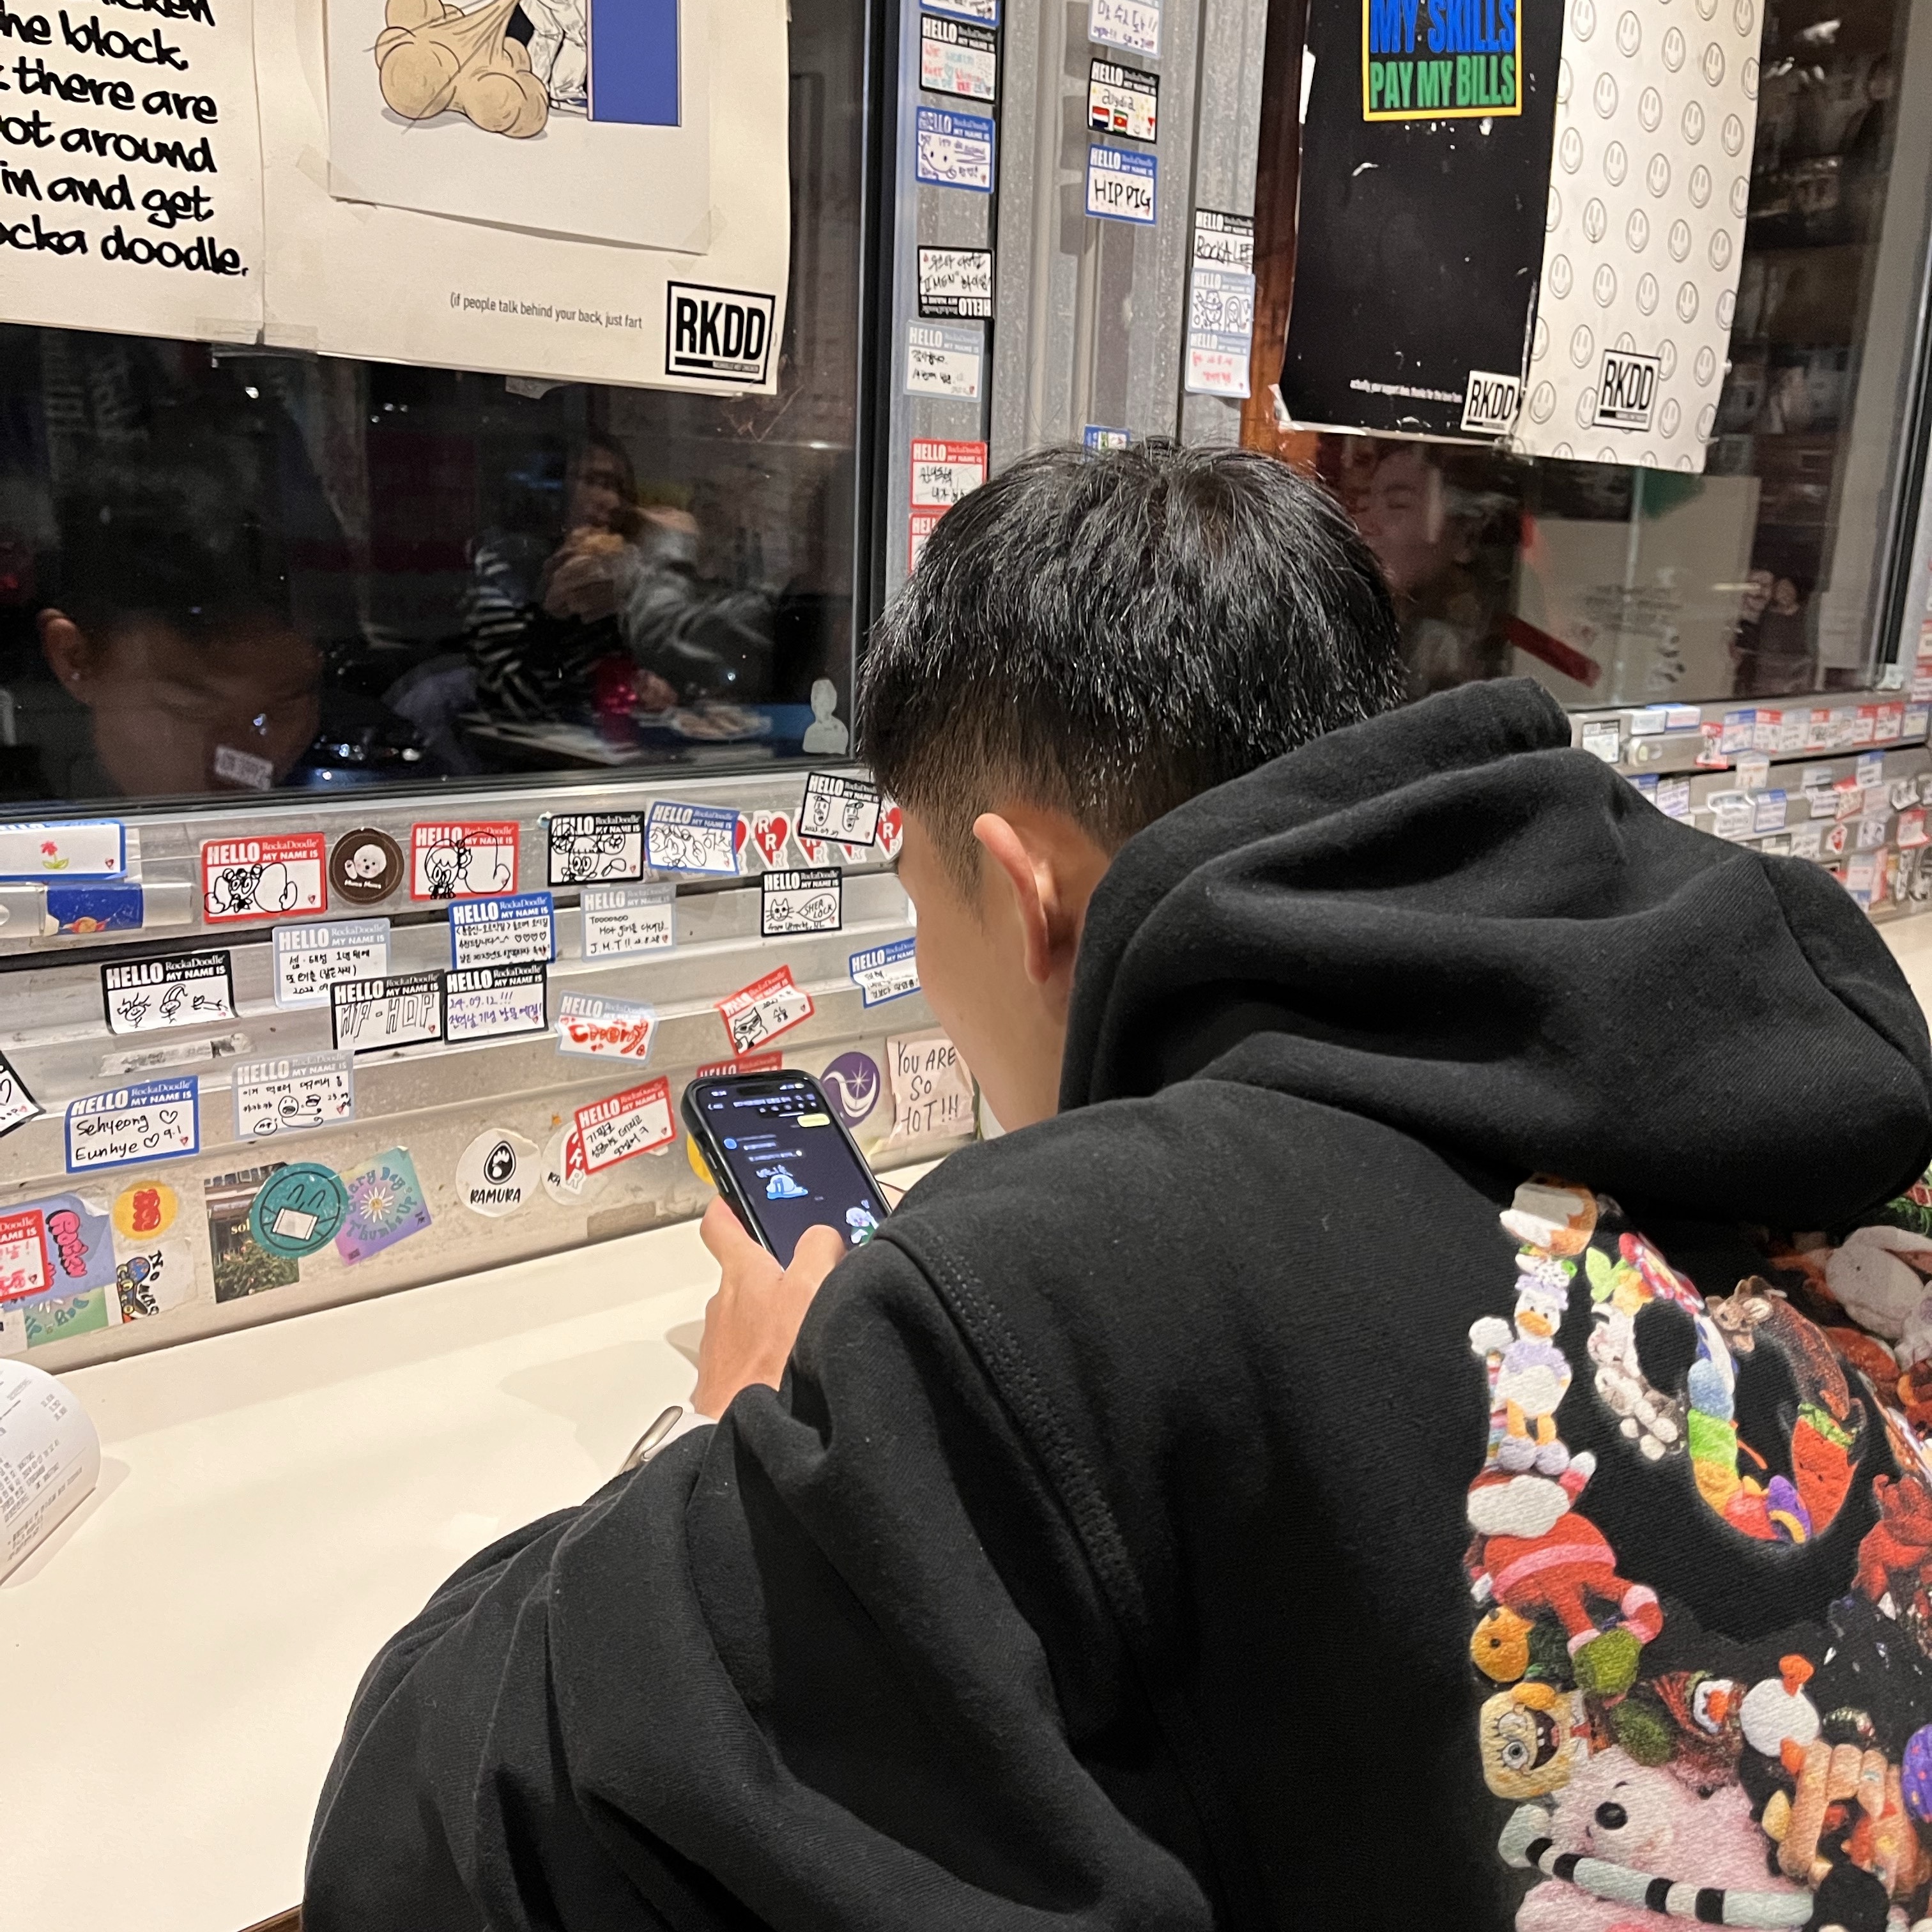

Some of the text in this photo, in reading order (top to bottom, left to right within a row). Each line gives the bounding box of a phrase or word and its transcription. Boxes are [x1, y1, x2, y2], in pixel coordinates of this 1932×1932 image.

[922, 17, 957, 43] HELLO
[1370, 0, 1515, 54] MY SKILLS
[59, 10, 189, 70] block
[1091, 61, 1124, 87] HELLO
[1370, 54, 1515, 109] PAY MY BILLS
[12, 56, 218, 124] there are
[60, 127, 217, 173] around
[1090, 148, 1121, 170] HELLO
[47, 174, 135, 210] and
[141, 185, 214, 229] get
[463, 296, 496, 312] people
[499, 300, 519, 314] talk
[520, 302, 552, 318] behind
[555, 309, 577, 322] your
[605, 314, 623, 327] just
[625, 314, 643, 329] fart
[958, 298, 992, 317] HELLO
[675, 296, 766, 360] RKDD
[908, 326, 943, 348] HELLO
[1601, 359, 1654, 410] RKDD
[1469, 379, 1515, 420] RKDD
[913, 443, 947, 462] HELLO
[808, 774, 845, 796] HELLO
[652, 804, 693, 824] HELLO
[261, 838, 318, 851] RockaDoodle
[416, 827, 463, 847] HELLO
[207, 842, 261, 865] HELLO
[262, 849, 318, 861] MY NAME IS
[763, 871, 801, 891] HELLO
[500, 896, 548, 910] RockaDoodle
[501, 906, 549, 919] MY NAME IS
[584, 891, 626, 912] HELLO
[453, 901, 499, 925] HELLO
[279, 928, 330, 951] HELLO
[331, 924, 385, 937] RockaDoodle
[332, 933, 385, 947] MY NAME IS
[165, 954, 226, 971] RockaDoodle
[852, 949, 885, 972] HELLO
[886, 954, 896, 963] MY
[105, 962, 164, 990] HELLO
[165, 965, 226, 982] MY NAME IS
[386, 973, 440, 988] RockaDoodle
[447, 969, 493, 993] HELLO
[493, 964, 542, 979] RockaDoodle
[494, 974, 542, 988] MY NAME IS
[334, 980, 384, 1005] HELLO
[386, 982, 439, 997] MY NAME IS
[560, 995, 604, 1018] HELLO
[292, 1061, 347, 1077] MY NAME IS
[925, 1046, 956, 1071] ARE
[237, 1060, 289, 1085] HELLO
[130, 1080, 192, 1097] RockaDoodle
[130, 1091, 192, 1107] MY NAME IS
[71, 1090, 128, 1116] HELLO
[76, 1114, 150, 1137] Sehyeong
[578, 1099, 620, 1130] HELLO
[75, 1142, 139, 1162] Eunhye
[26, 1227, 37, 1237] IS
